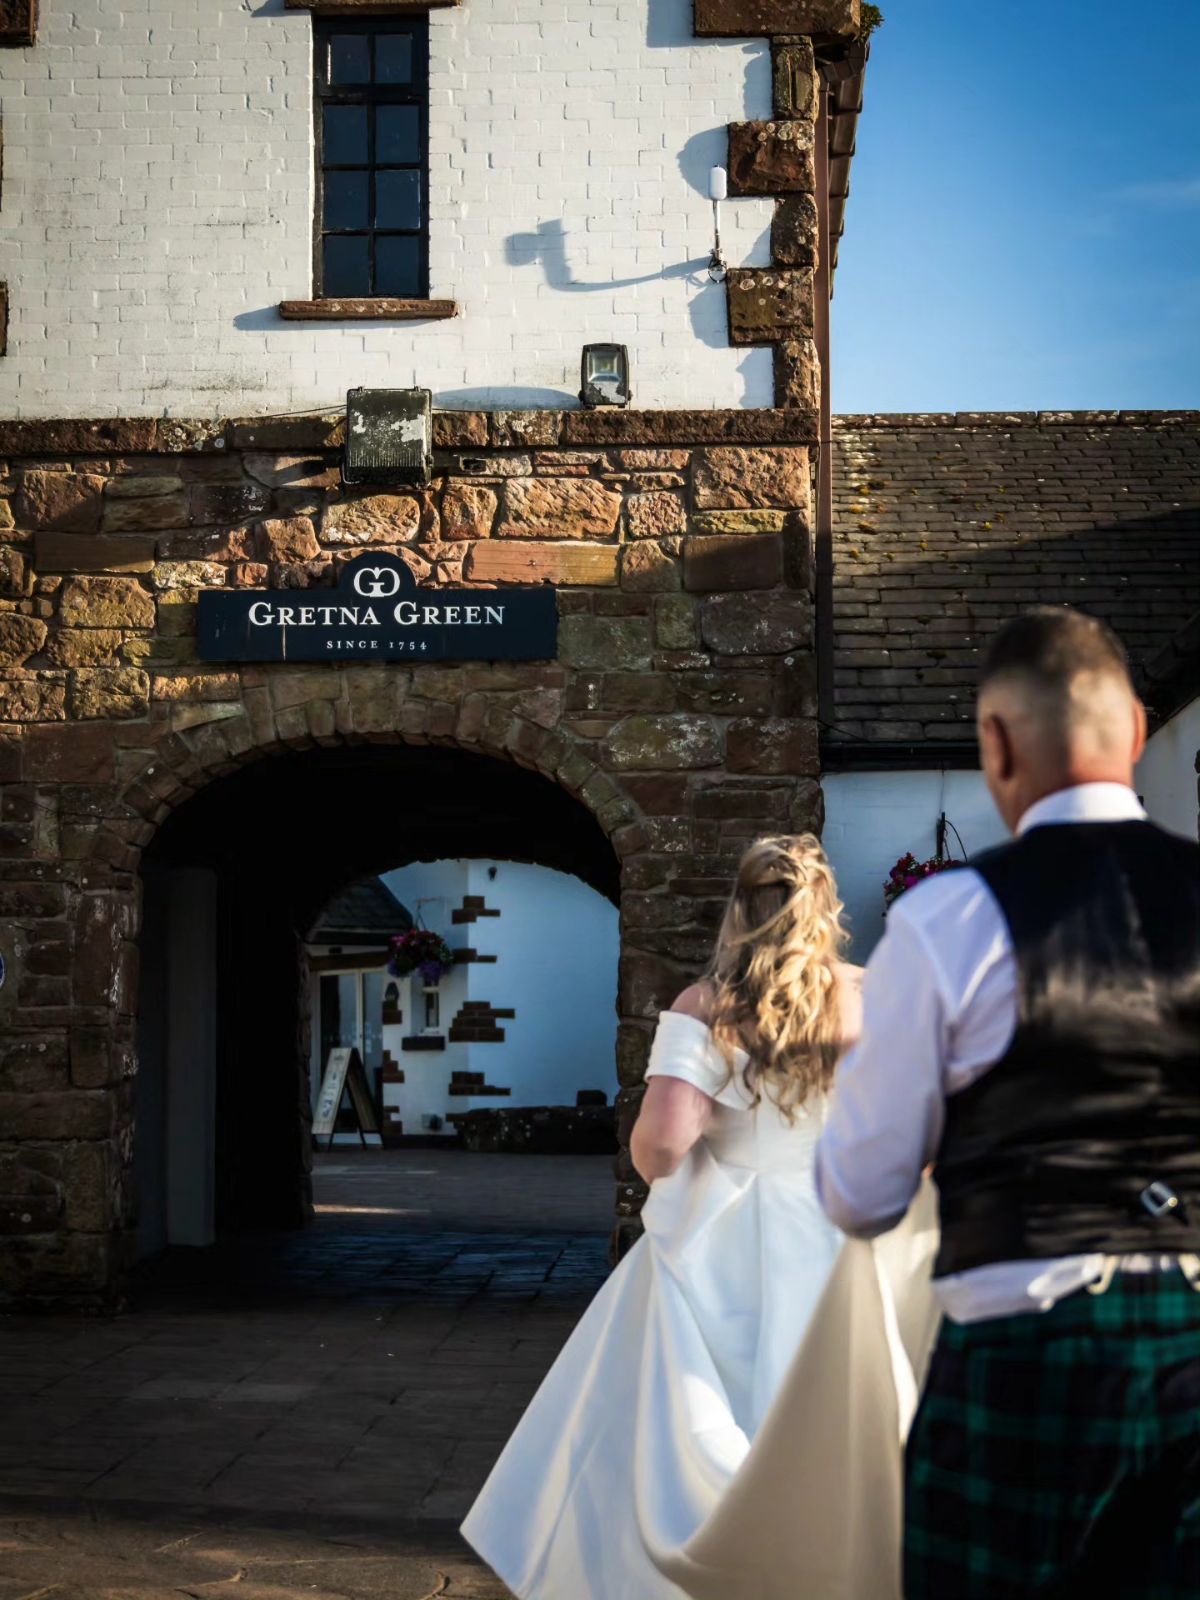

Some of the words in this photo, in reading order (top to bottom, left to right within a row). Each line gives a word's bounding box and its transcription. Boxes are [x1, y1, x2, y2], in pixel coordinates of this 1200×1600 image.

[248, 601, 382, 626] GRETNA
[393, 601, 506, 626] GREEN
[326, 640, 379, 650] SINCE
[389, 641, 428, 651] 1754
